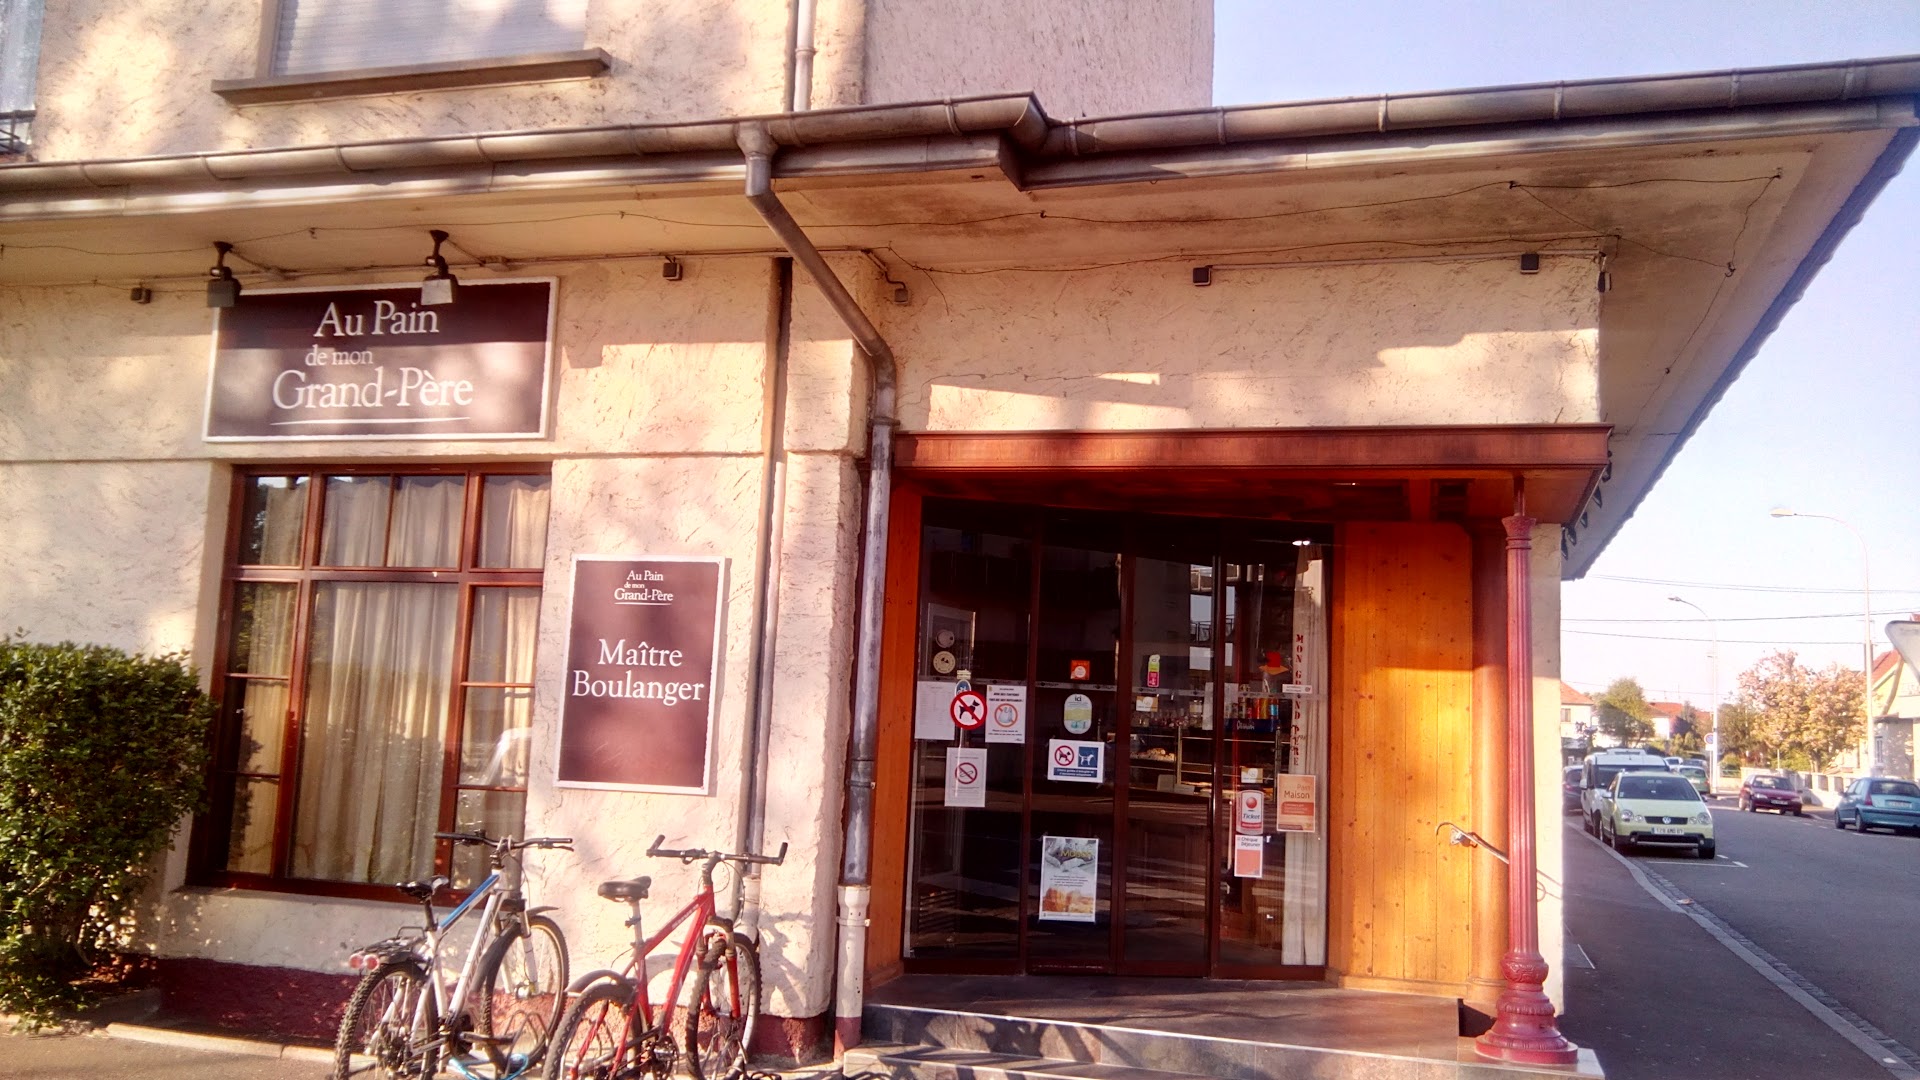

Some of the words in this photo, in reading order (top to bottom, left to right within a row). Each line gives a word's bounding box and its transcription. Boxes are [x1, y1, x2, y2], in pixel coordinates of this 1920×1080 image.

[313, 302, 364, 337] Au
[371, 300, 440, 336] Pain
[305, 344, 327, 366] de
[332, 350, 374, 365] mon
[272, 366, 474, 410] Grand-Père
[626, 570, 642, 581] Au
[644, 570, 664, 581] Pain
[614, 588, 674, 601] Grand-Père
[598, 638, 683, 667] Maître
[1295, 634, 1304, 664] MON
[572, 670, 705, 706] Boulanger
[1283, 790, 1311, 799] Maison
